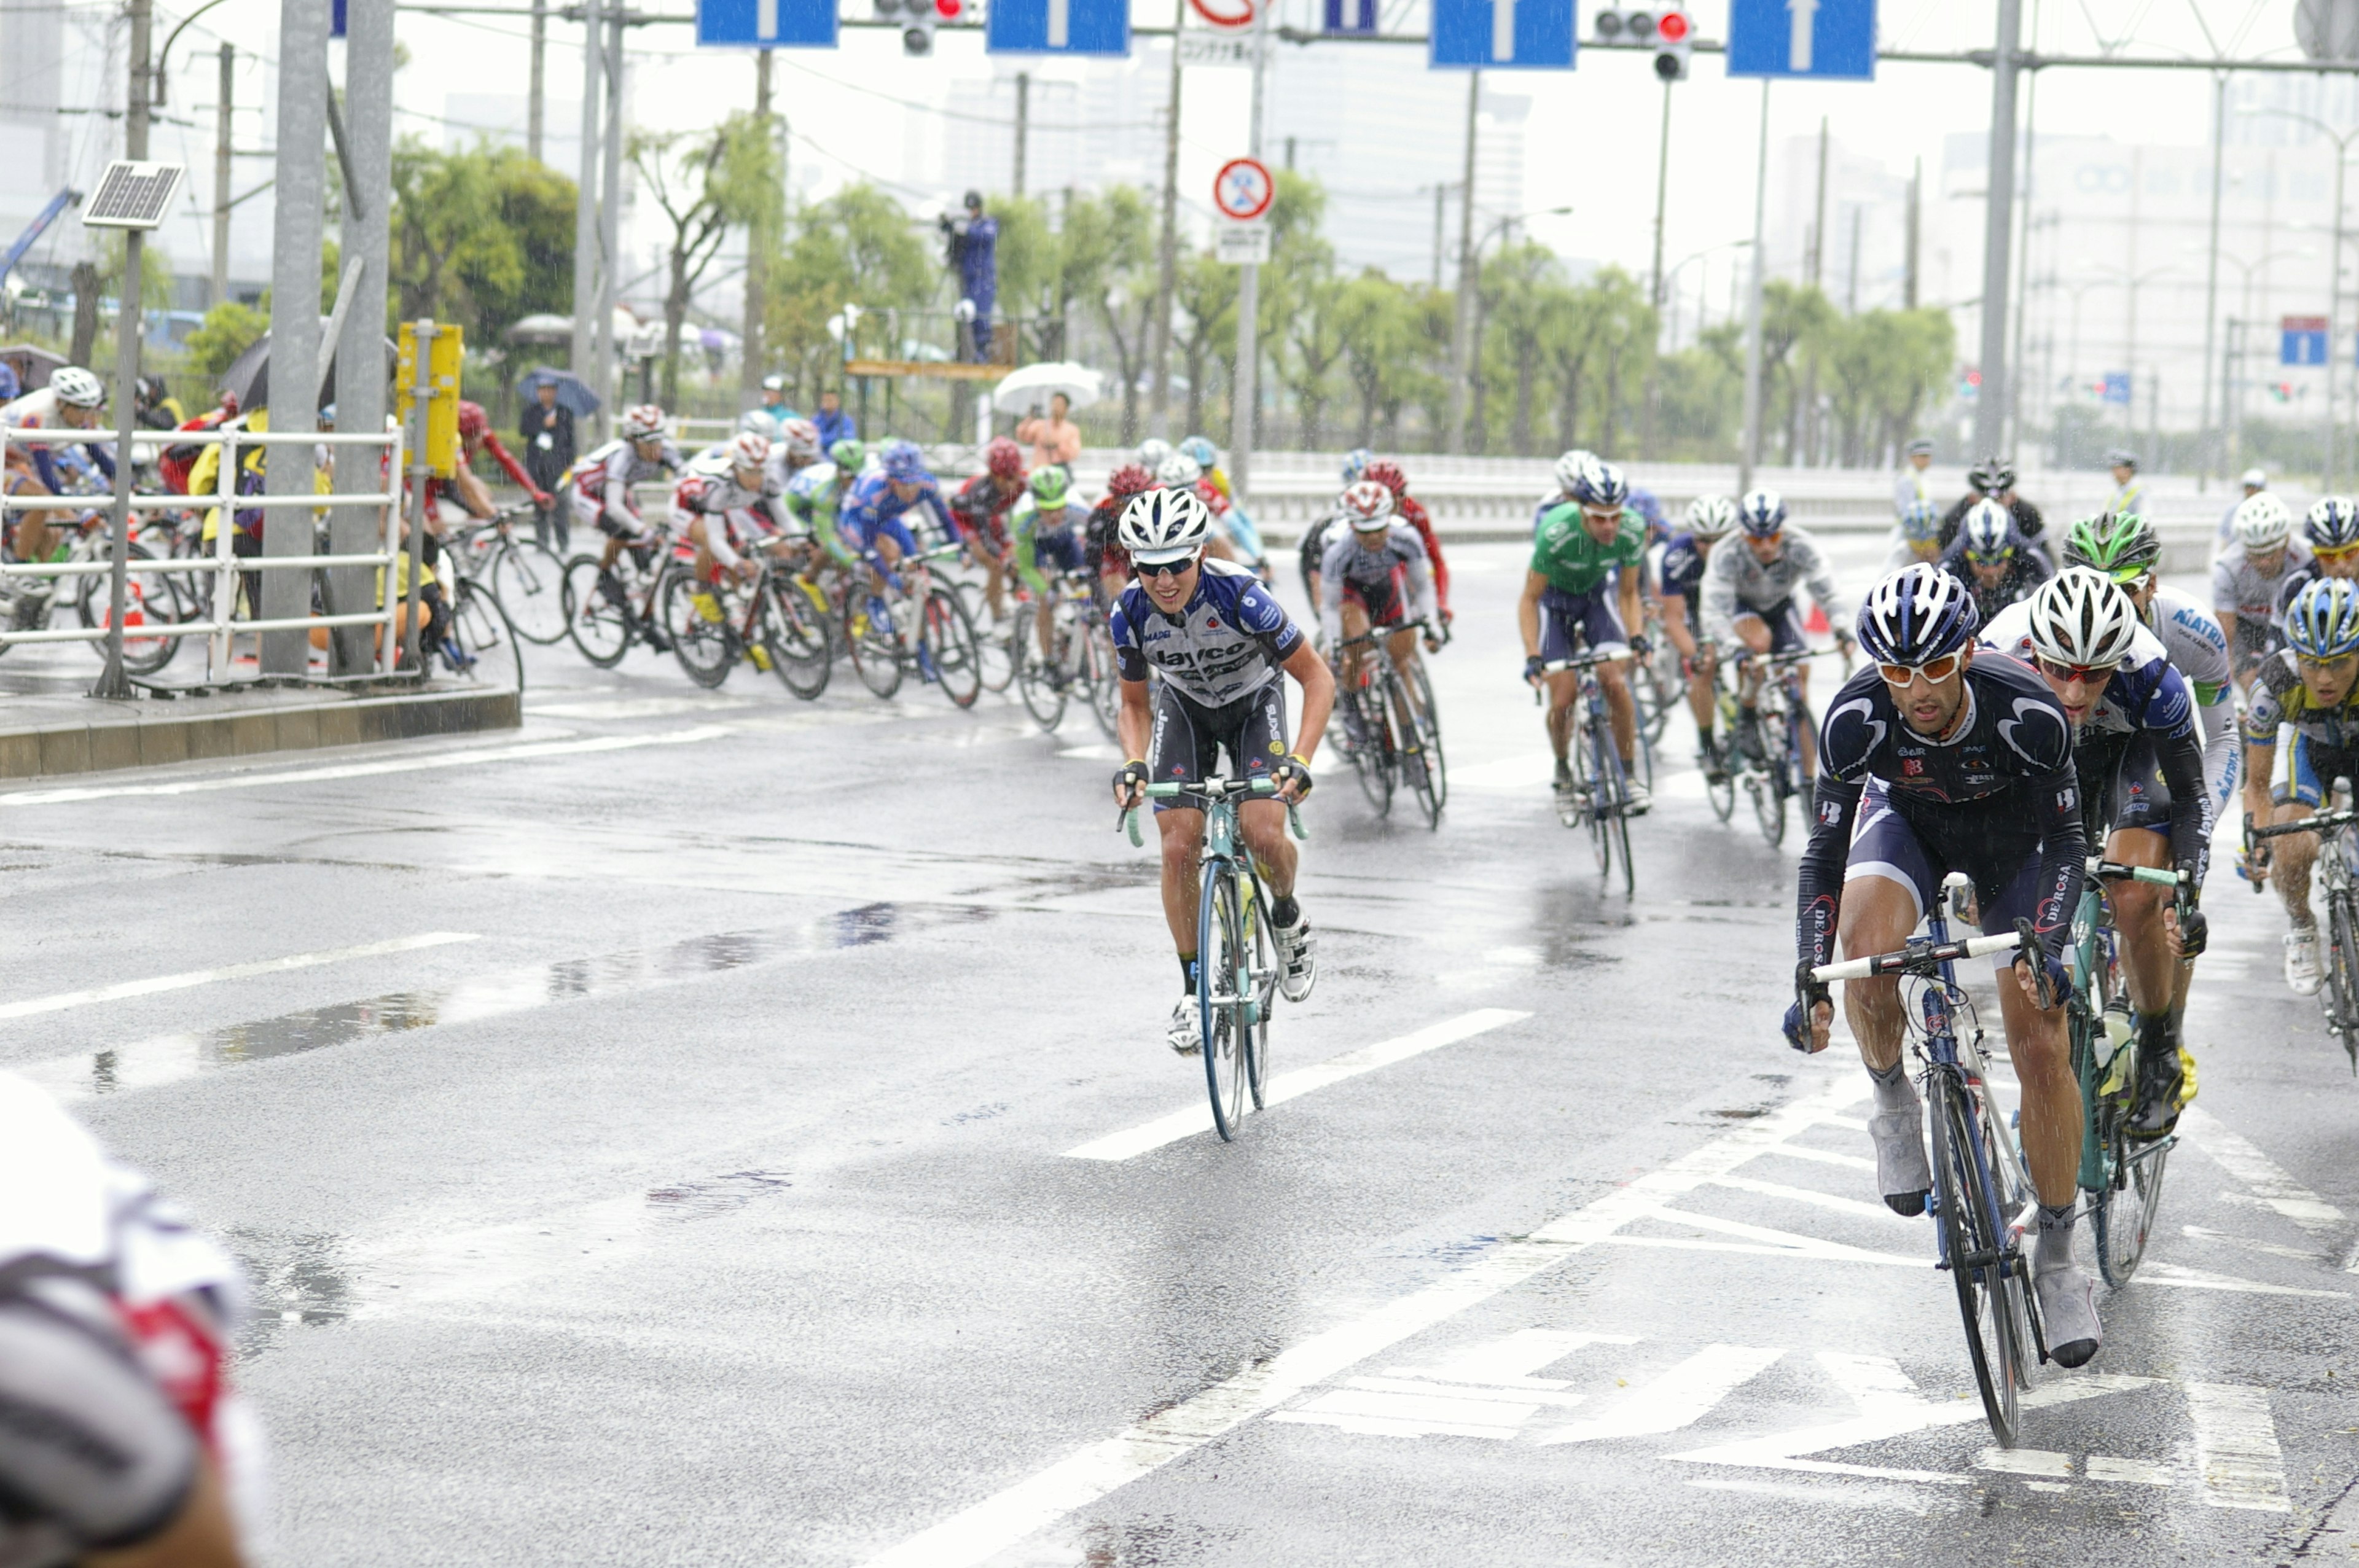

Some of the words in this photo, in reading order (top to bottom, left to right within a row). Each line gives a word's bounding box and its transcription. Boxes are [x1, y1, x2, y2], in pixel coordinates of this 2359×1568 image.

[2172, 609, 2226, 653] MATRIX
[1156, 642, 1246, 666] Jayco
[2216, 749, 2239, 802] MATRIX
[2053, 865, 2071, 902] ROSA
[1815, 909, 1826, 929] DE
[2046, 903, 2062, 921] DE
